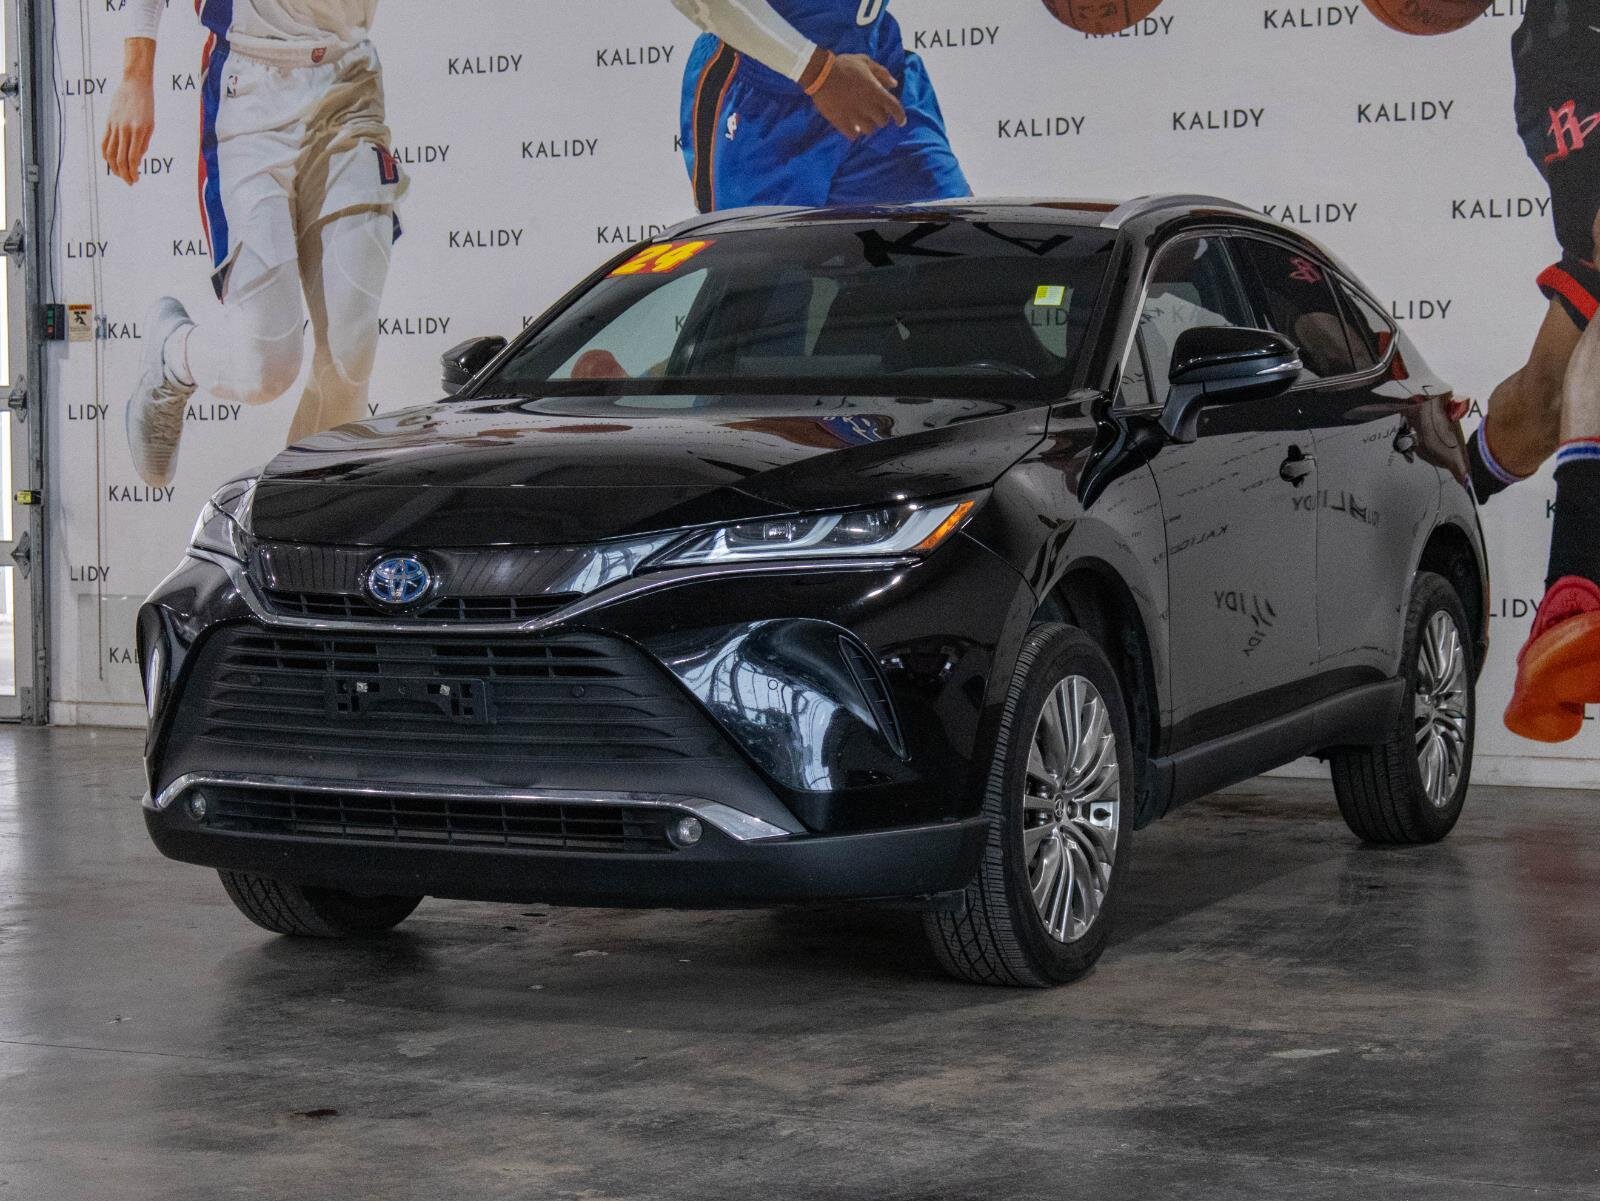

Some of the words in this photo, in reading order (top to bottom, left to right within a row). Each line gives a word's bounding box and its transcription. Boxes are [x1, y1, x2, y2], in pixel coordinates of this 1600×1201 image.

[1264, 6, 1359, 29] KALIDY
[914, 26, 999, 49] KALIDY
[448, 55, 523, 75] KALIDY
[597, 46, 674, 67] KALIDY
[62, 78, 107, 96] LIDY
[1172, 109, 1265, 131] KALIDY
[1357, 101, 1454, 123] KALIDY
[998, 117, 1085, 138] KALIDY
[522, 139, 598, 159] KALIDY
[1263, 203, 1357, 223] KALIDY
[1453, 197, 1550, 219] KALIDY
[449, 229, 523, 248] KALIDY
[597, 225, 669, 244] KALID
[378, 317, 451, 335] KALIDY
[108, 485, 175, 502] KALIDY
